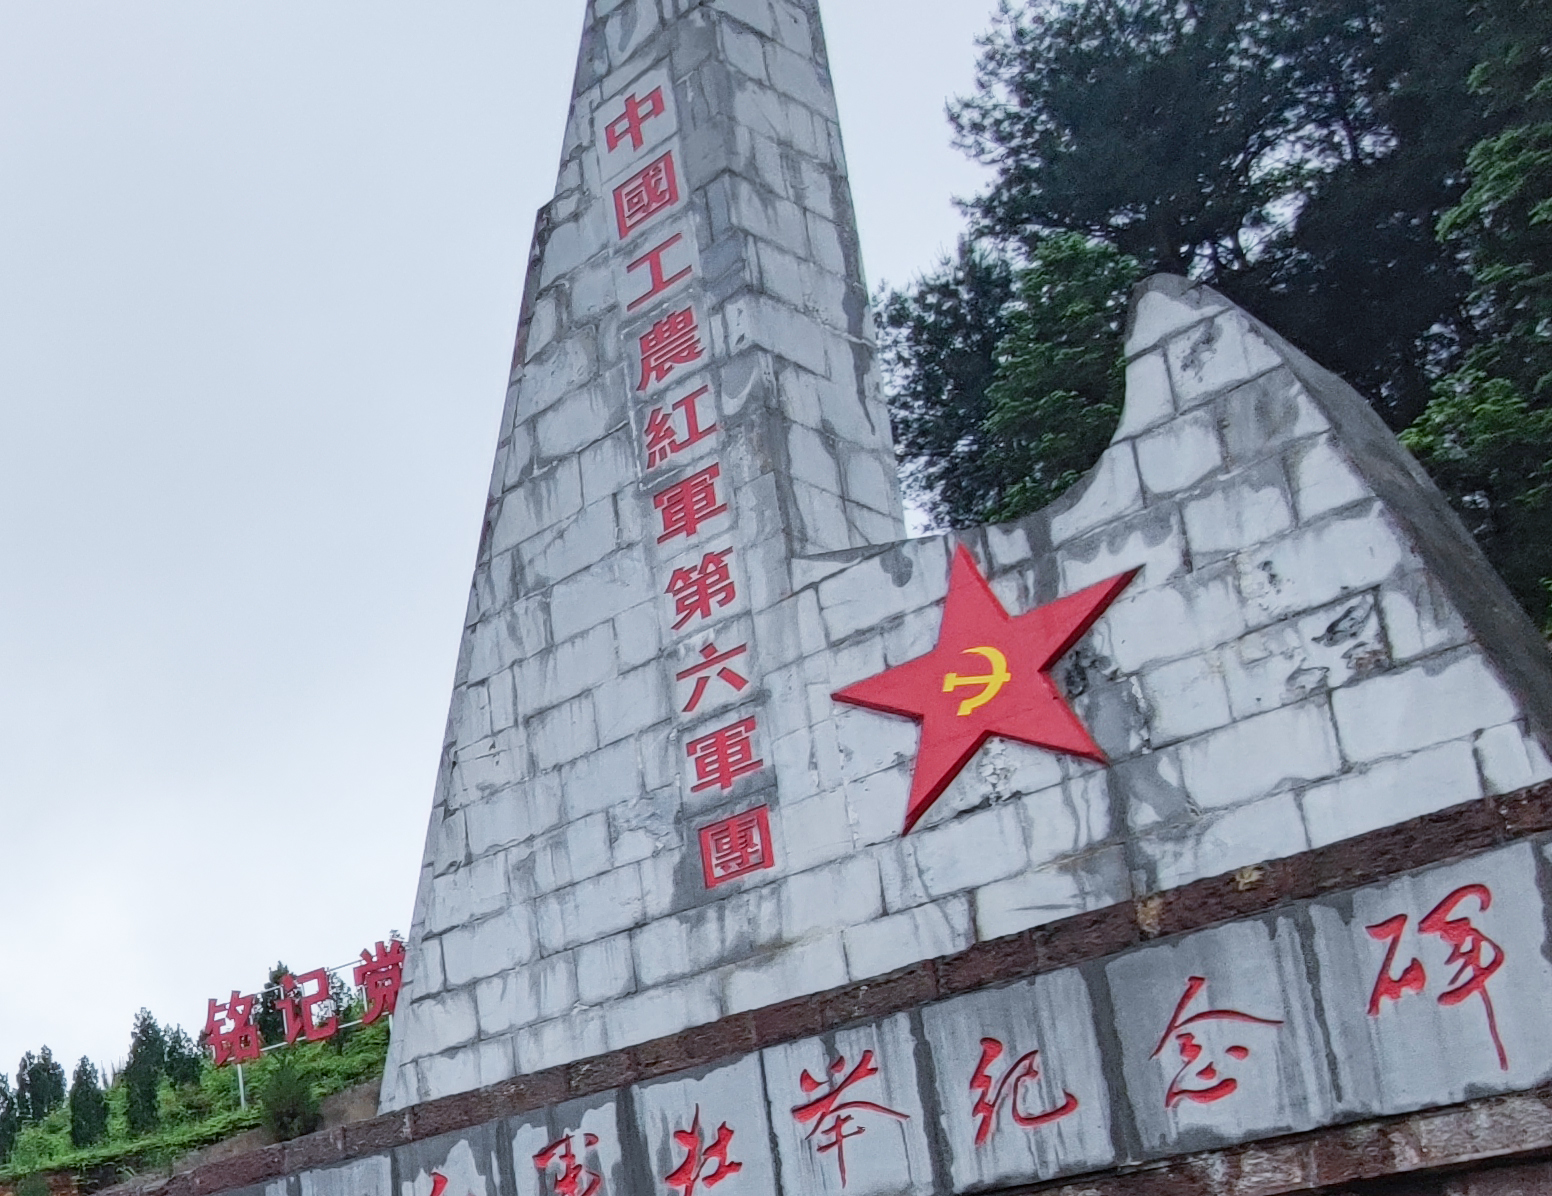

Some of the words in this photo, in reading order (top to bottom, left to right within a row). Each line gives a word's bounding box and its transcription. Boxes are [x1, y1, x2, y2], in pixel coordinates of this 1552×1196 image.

[604, 86, 776, 889] 中國工農紅軍第六軍團
[204, 939, 406, 1067] 铭记党
